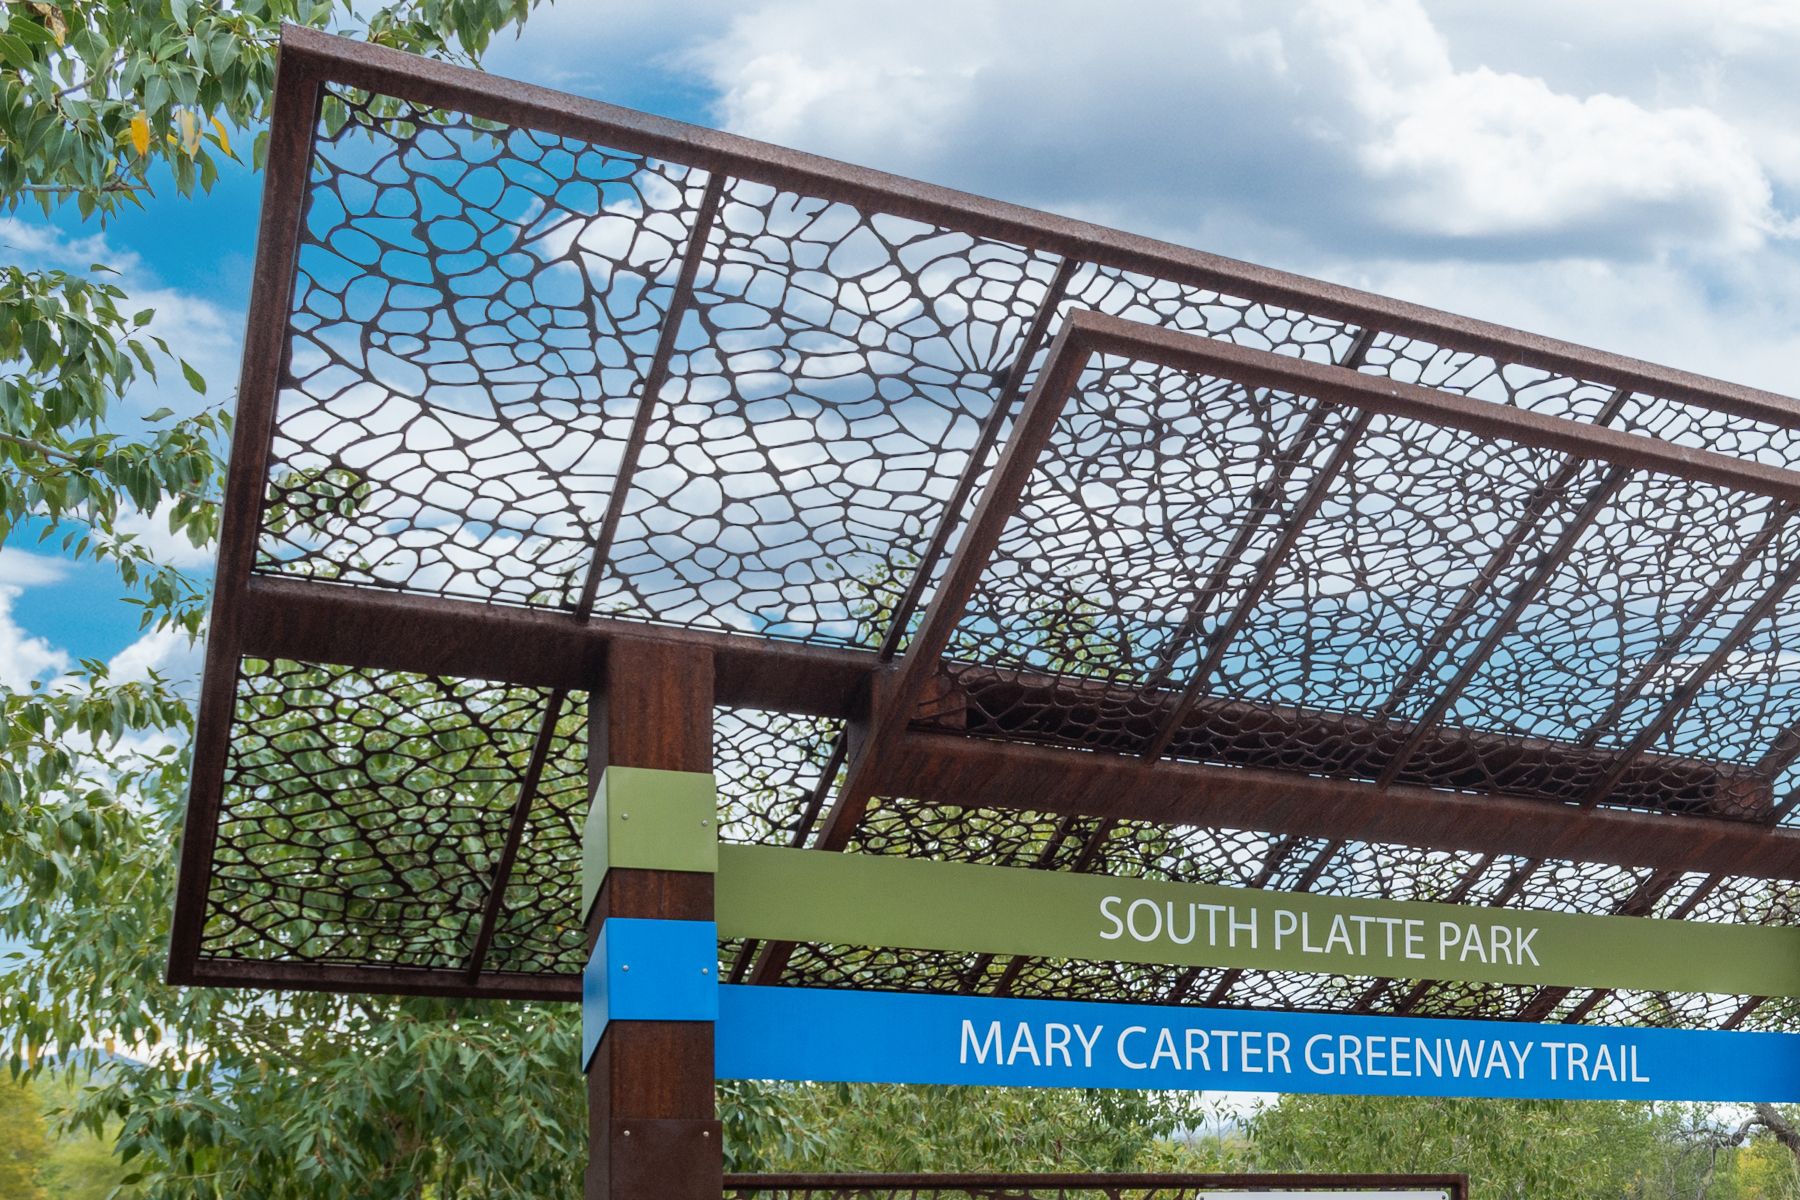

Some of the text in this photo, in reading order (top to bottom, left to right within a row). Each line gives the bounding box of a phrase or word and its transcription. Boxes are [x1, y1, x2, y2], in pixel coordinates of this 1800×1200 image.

[1099, 895, 1540, 967] SOUTH PLATTE PARK
[959, 1018, 1650, 1083] MARY CARTER GREENWAY TRAIL
